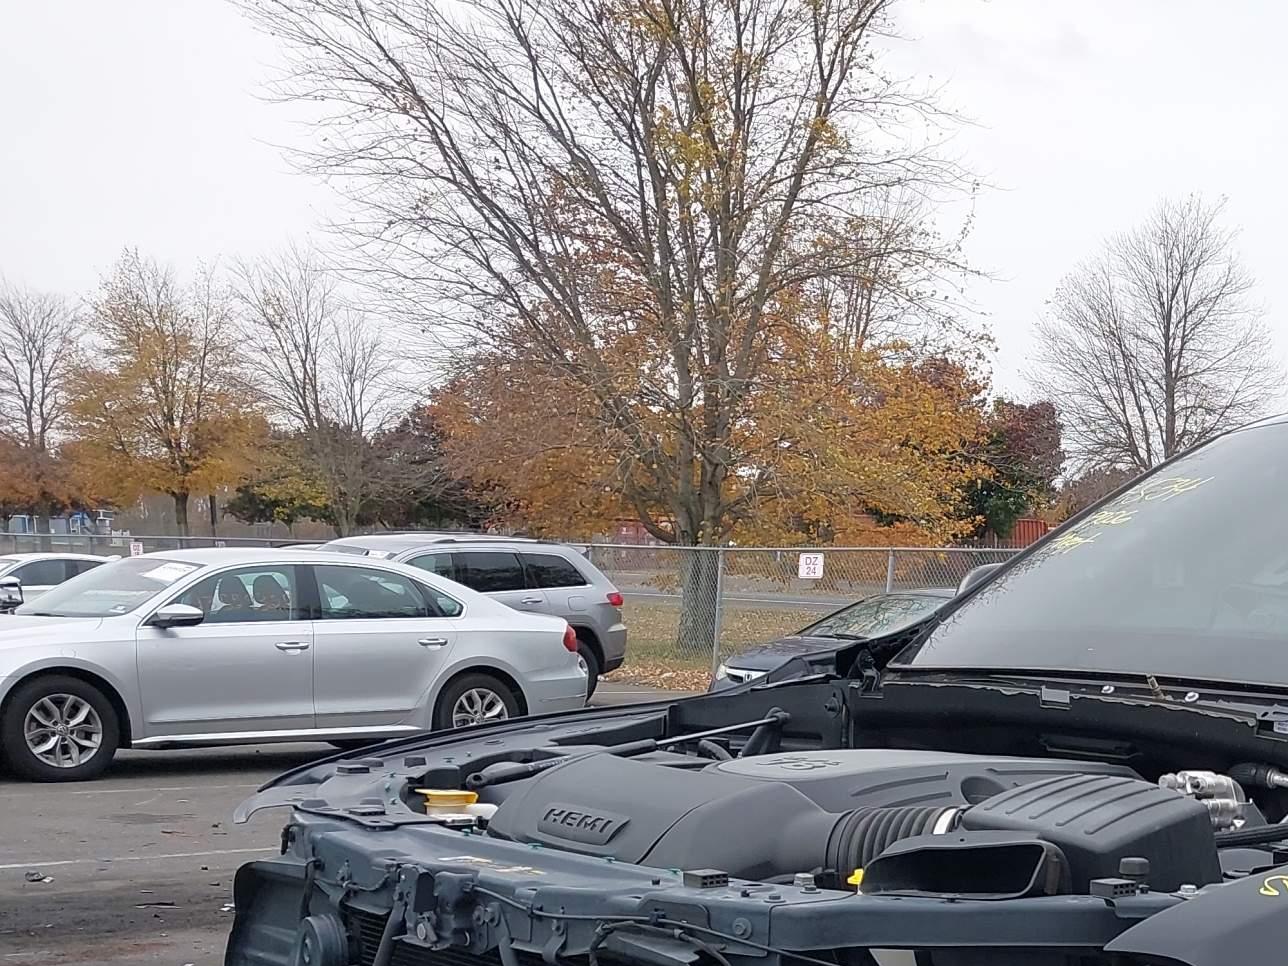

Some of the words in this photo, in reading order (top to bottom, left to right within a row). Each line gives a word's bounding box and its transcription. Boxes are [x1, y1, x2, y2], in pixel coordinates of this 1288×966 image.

[805, 556, 819, 566] DZ
[806, 566, 817, 576] 24
[542, 807, 613, 834] HEMI
